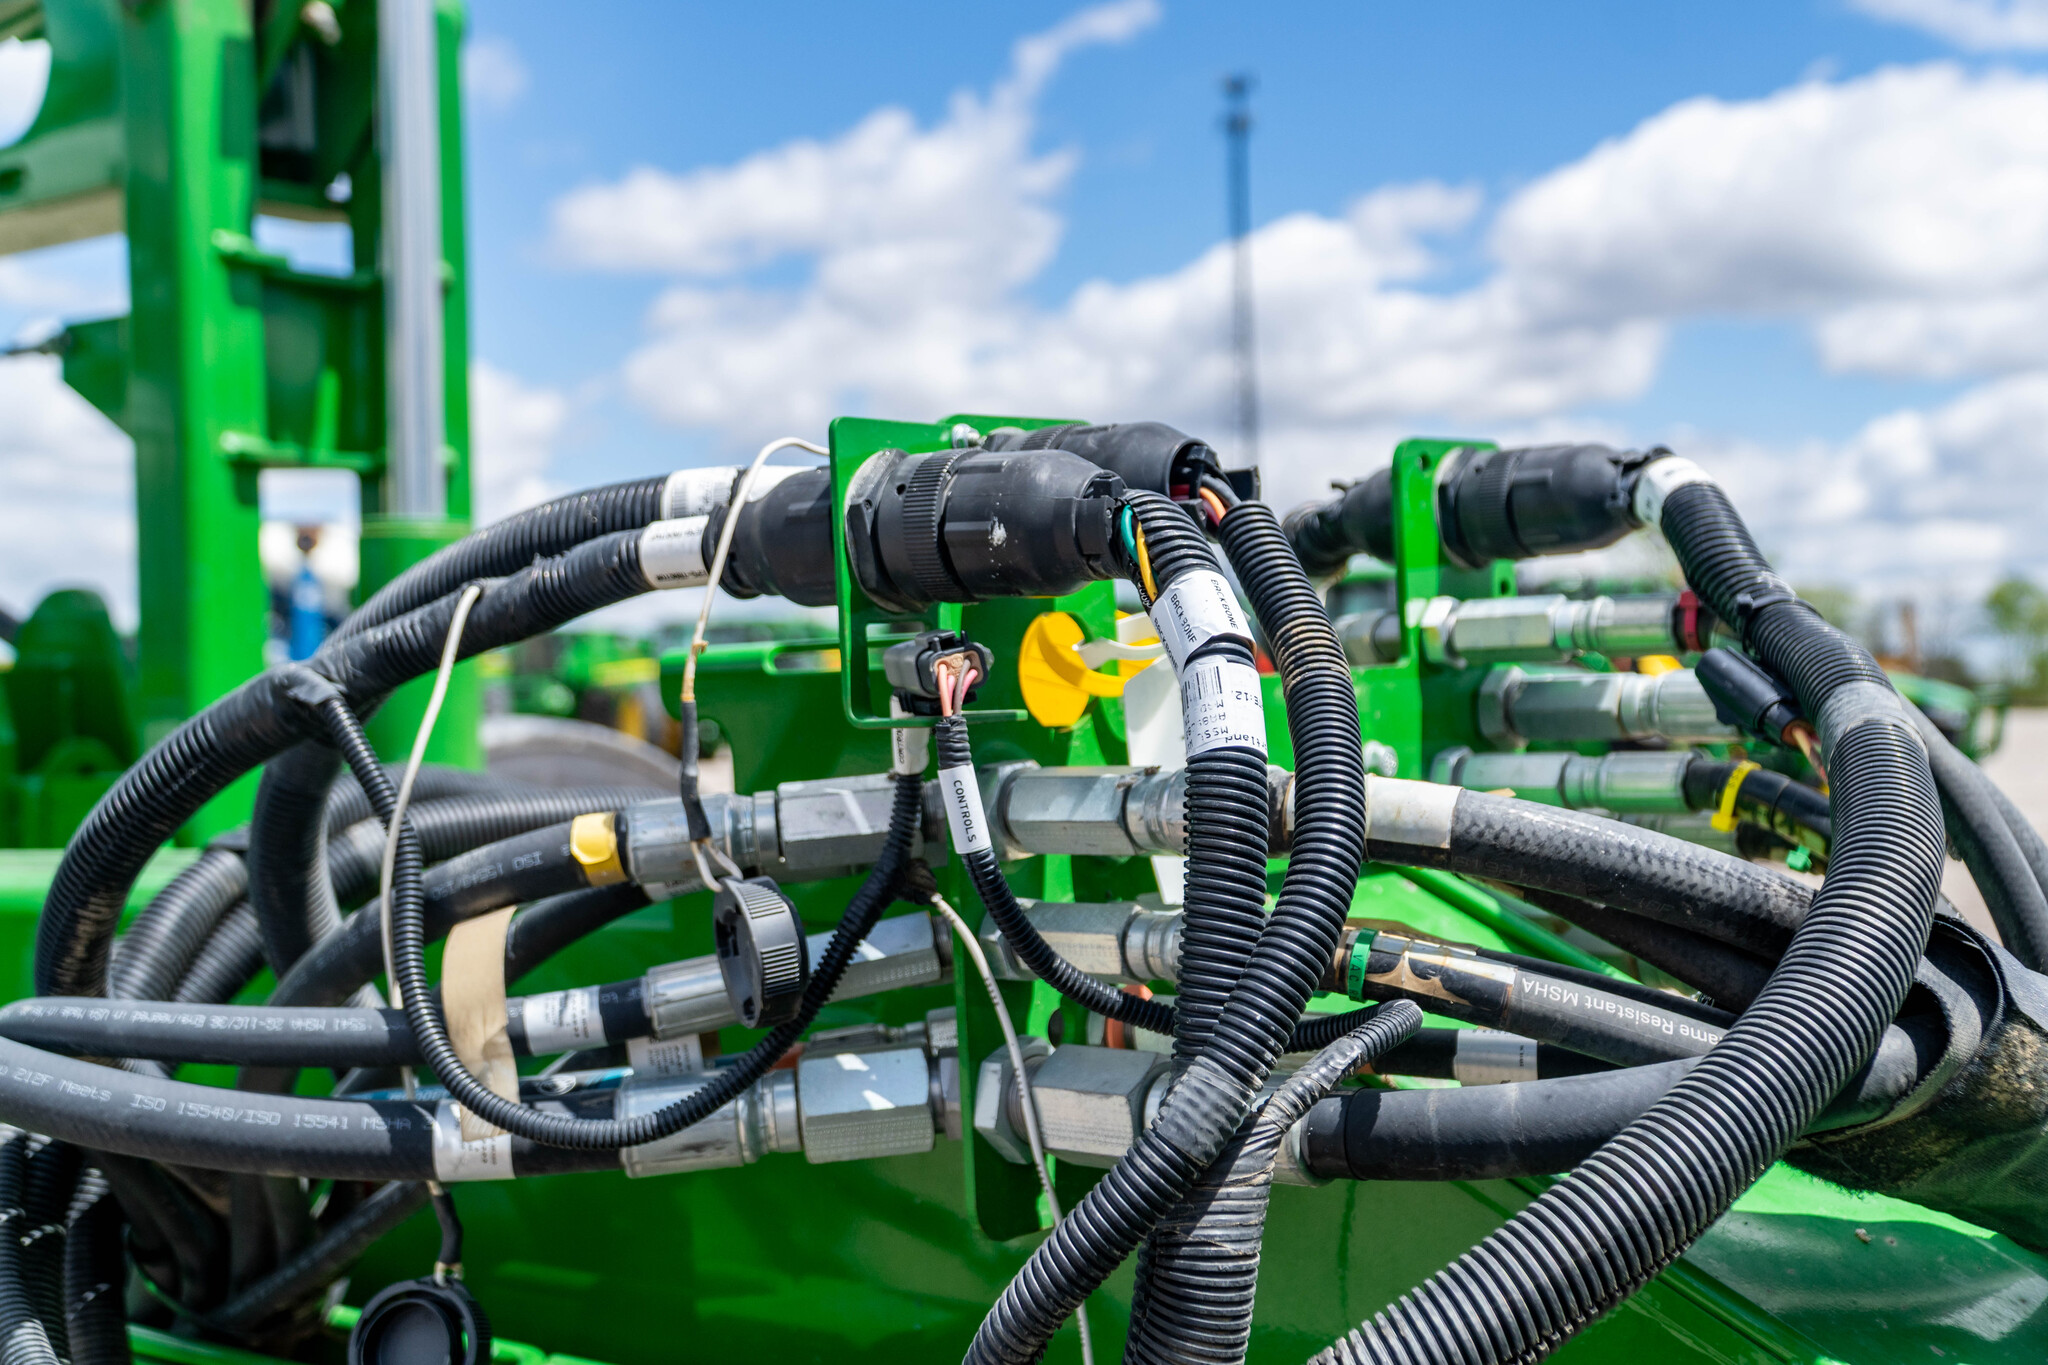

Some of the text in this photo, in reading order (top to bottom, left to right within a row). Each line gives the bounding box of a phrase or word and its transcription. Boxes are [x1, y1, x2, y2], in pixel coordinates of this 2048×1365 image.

[1211, 578, 1239, 630] BACKBONE
[953, 779, 977, 843] CONTROLS
[1349, 953, 1364, 982] VAC
[1521, 977, 1579, 1007] MSHA
[1584, 995, 1674, 1035] Resistant
[57, 1078, 113, 1103] Meets
[129, 1092, 168, 1113] ISO
[177, 1101, 282, 1127] 15540/ISO
[292, 1112, 349, 1131] 15541
[361, 1115, 412, 1132] MSHA
